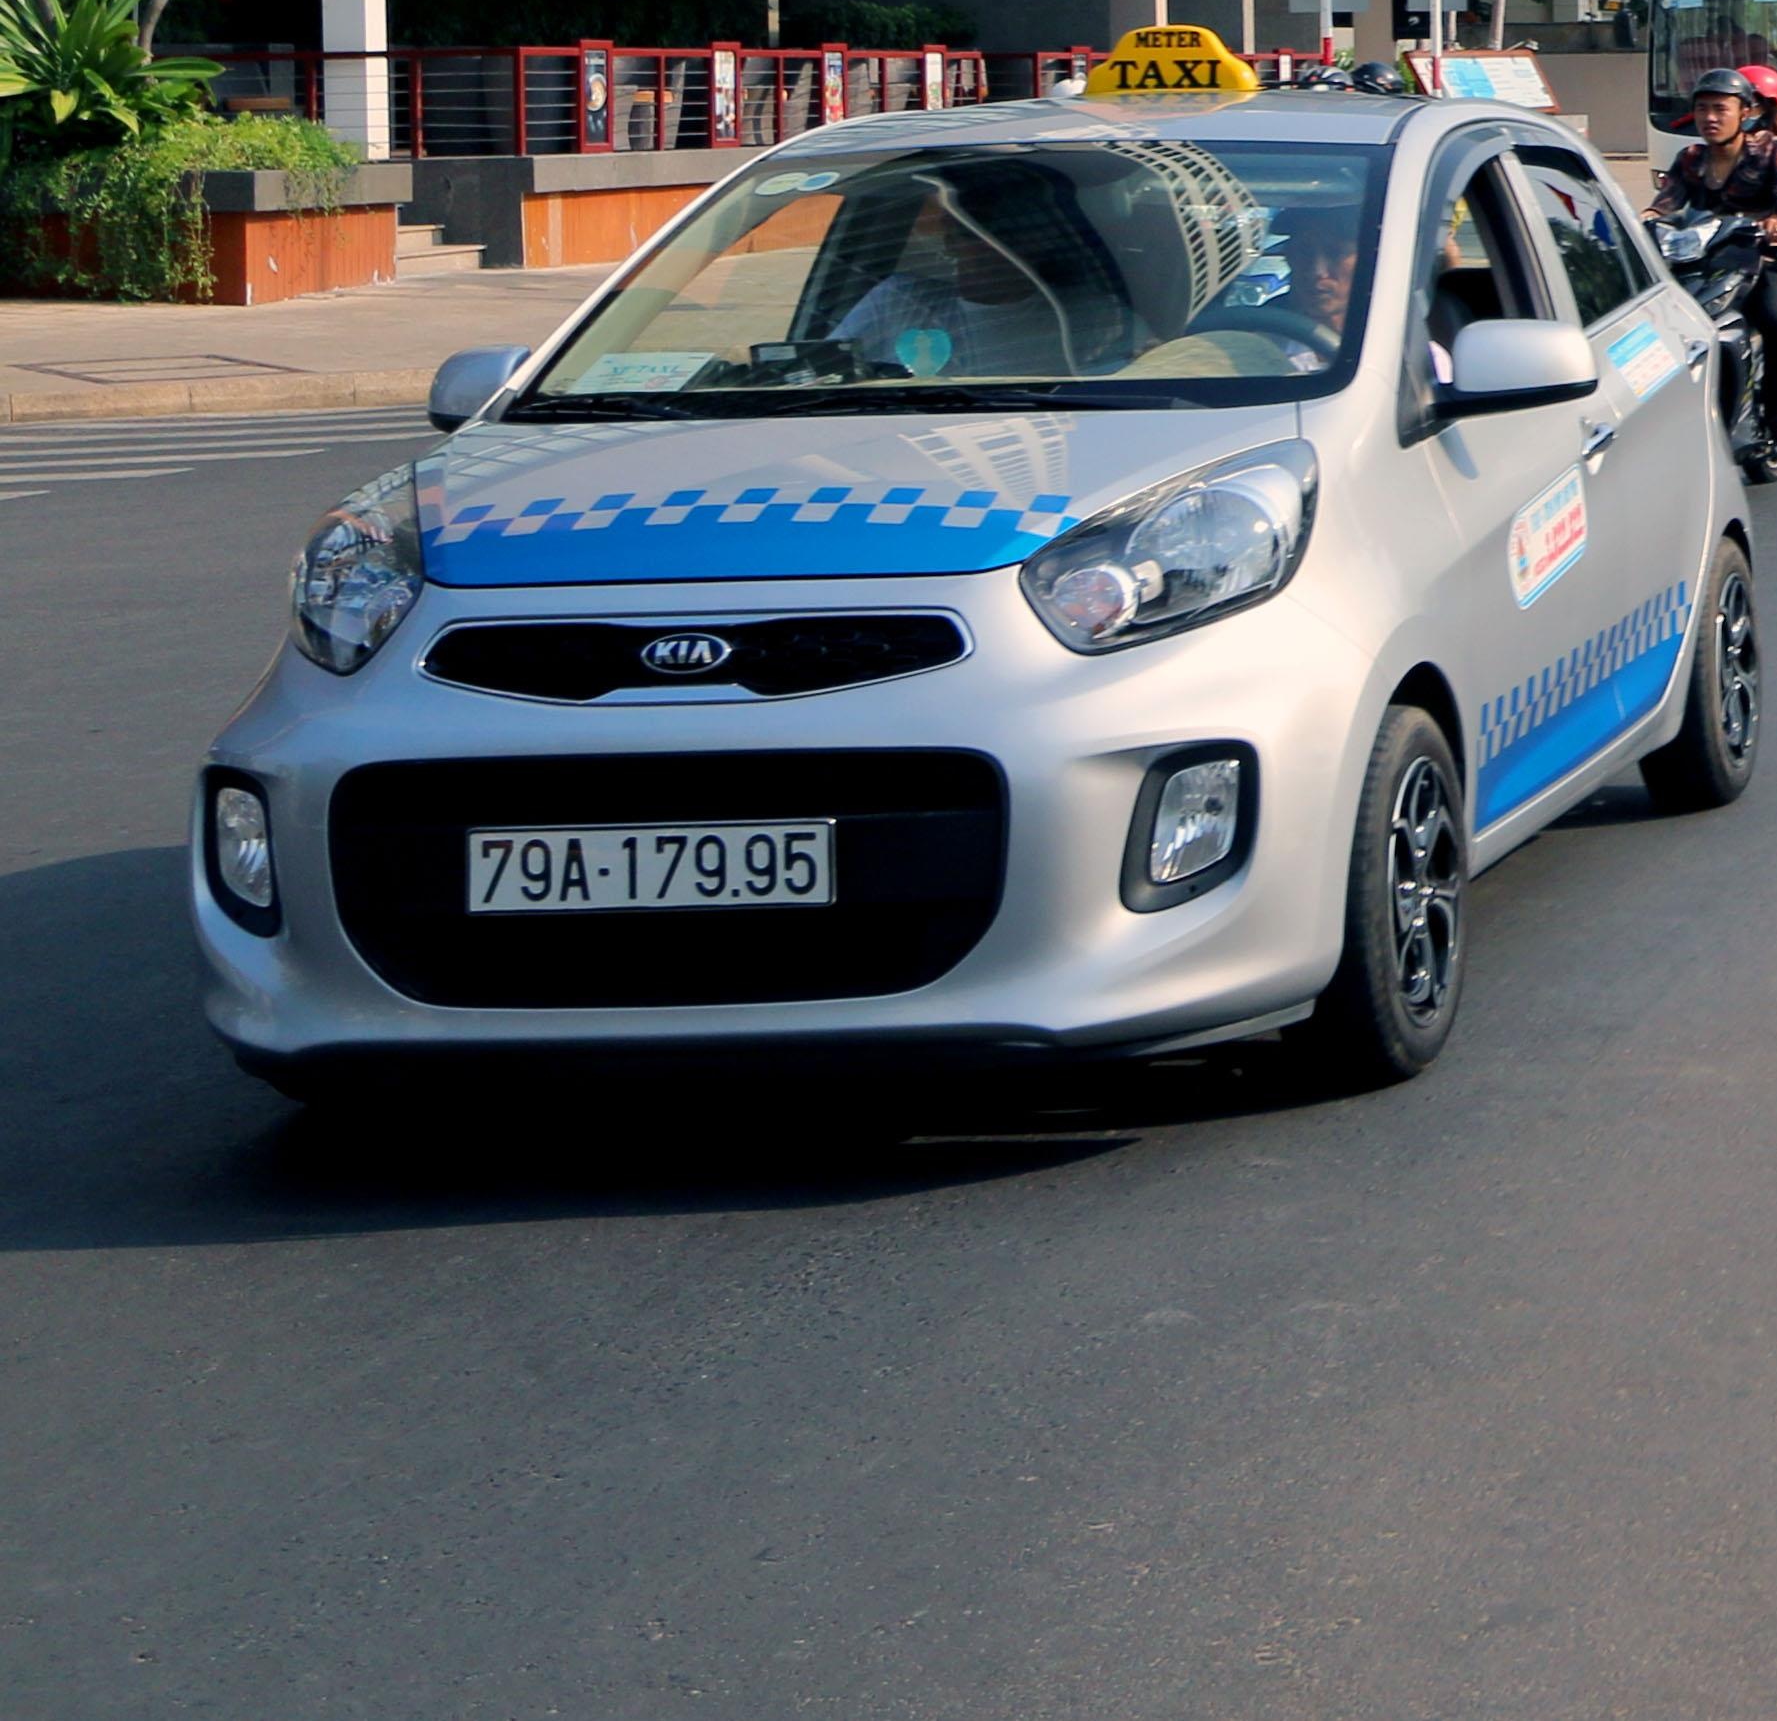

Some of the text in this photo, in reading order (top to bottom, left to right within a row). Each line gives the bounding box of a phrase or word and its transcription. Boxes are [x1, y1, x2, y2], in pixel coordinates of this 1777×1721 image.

[1135, 31, 1202, 48] METER
[1109, 60, 1221, 89] TAXI
[653, 641, 711, 665] KIA
[480, 832, 817, 904] 79A-179.95
